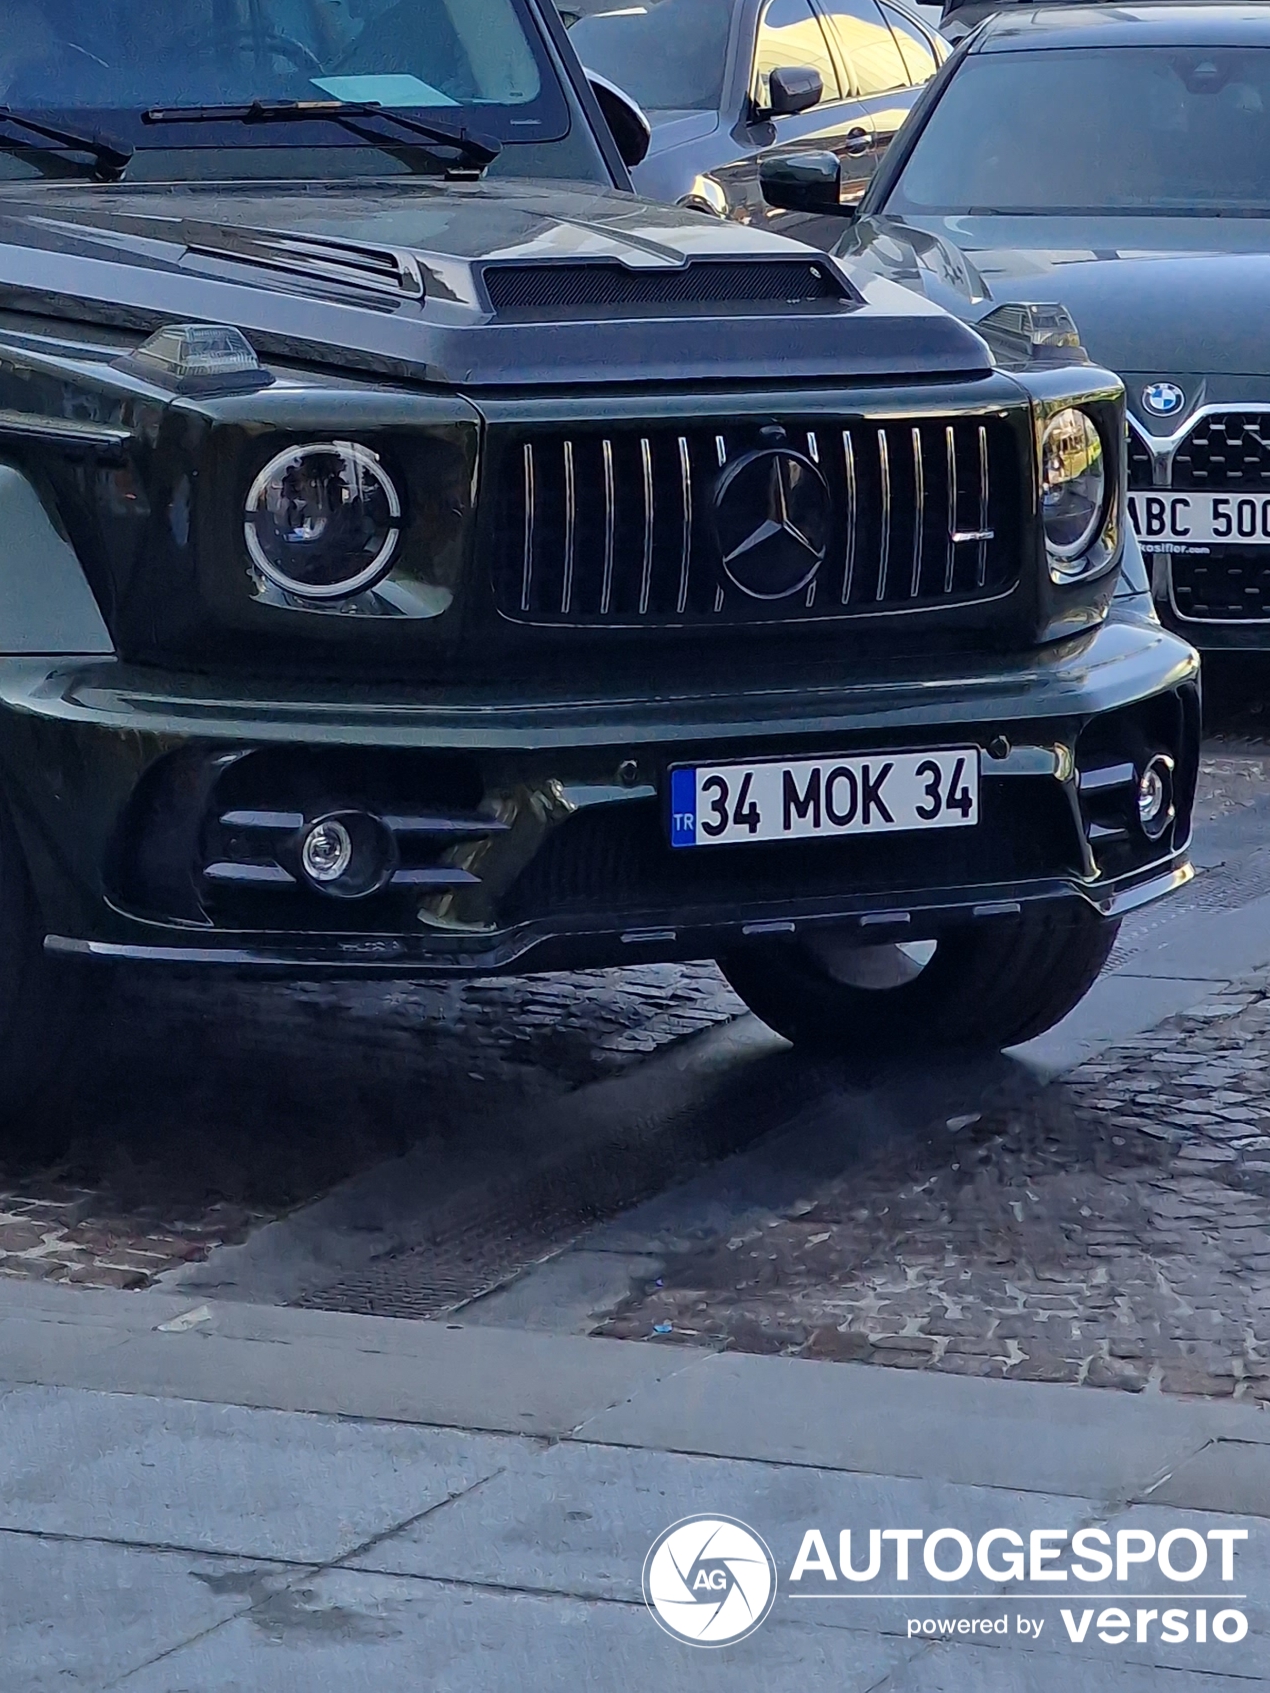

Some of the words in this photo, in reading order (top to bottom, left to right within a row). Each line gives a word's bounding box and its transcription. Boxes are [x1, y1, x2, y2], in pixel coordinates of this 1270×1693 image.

[701, 771, 761, 837] 34
[782, 762, 895, 831] MOK
[915, 757, 973, 821] 34
[673, 813, 695, 831] TR
